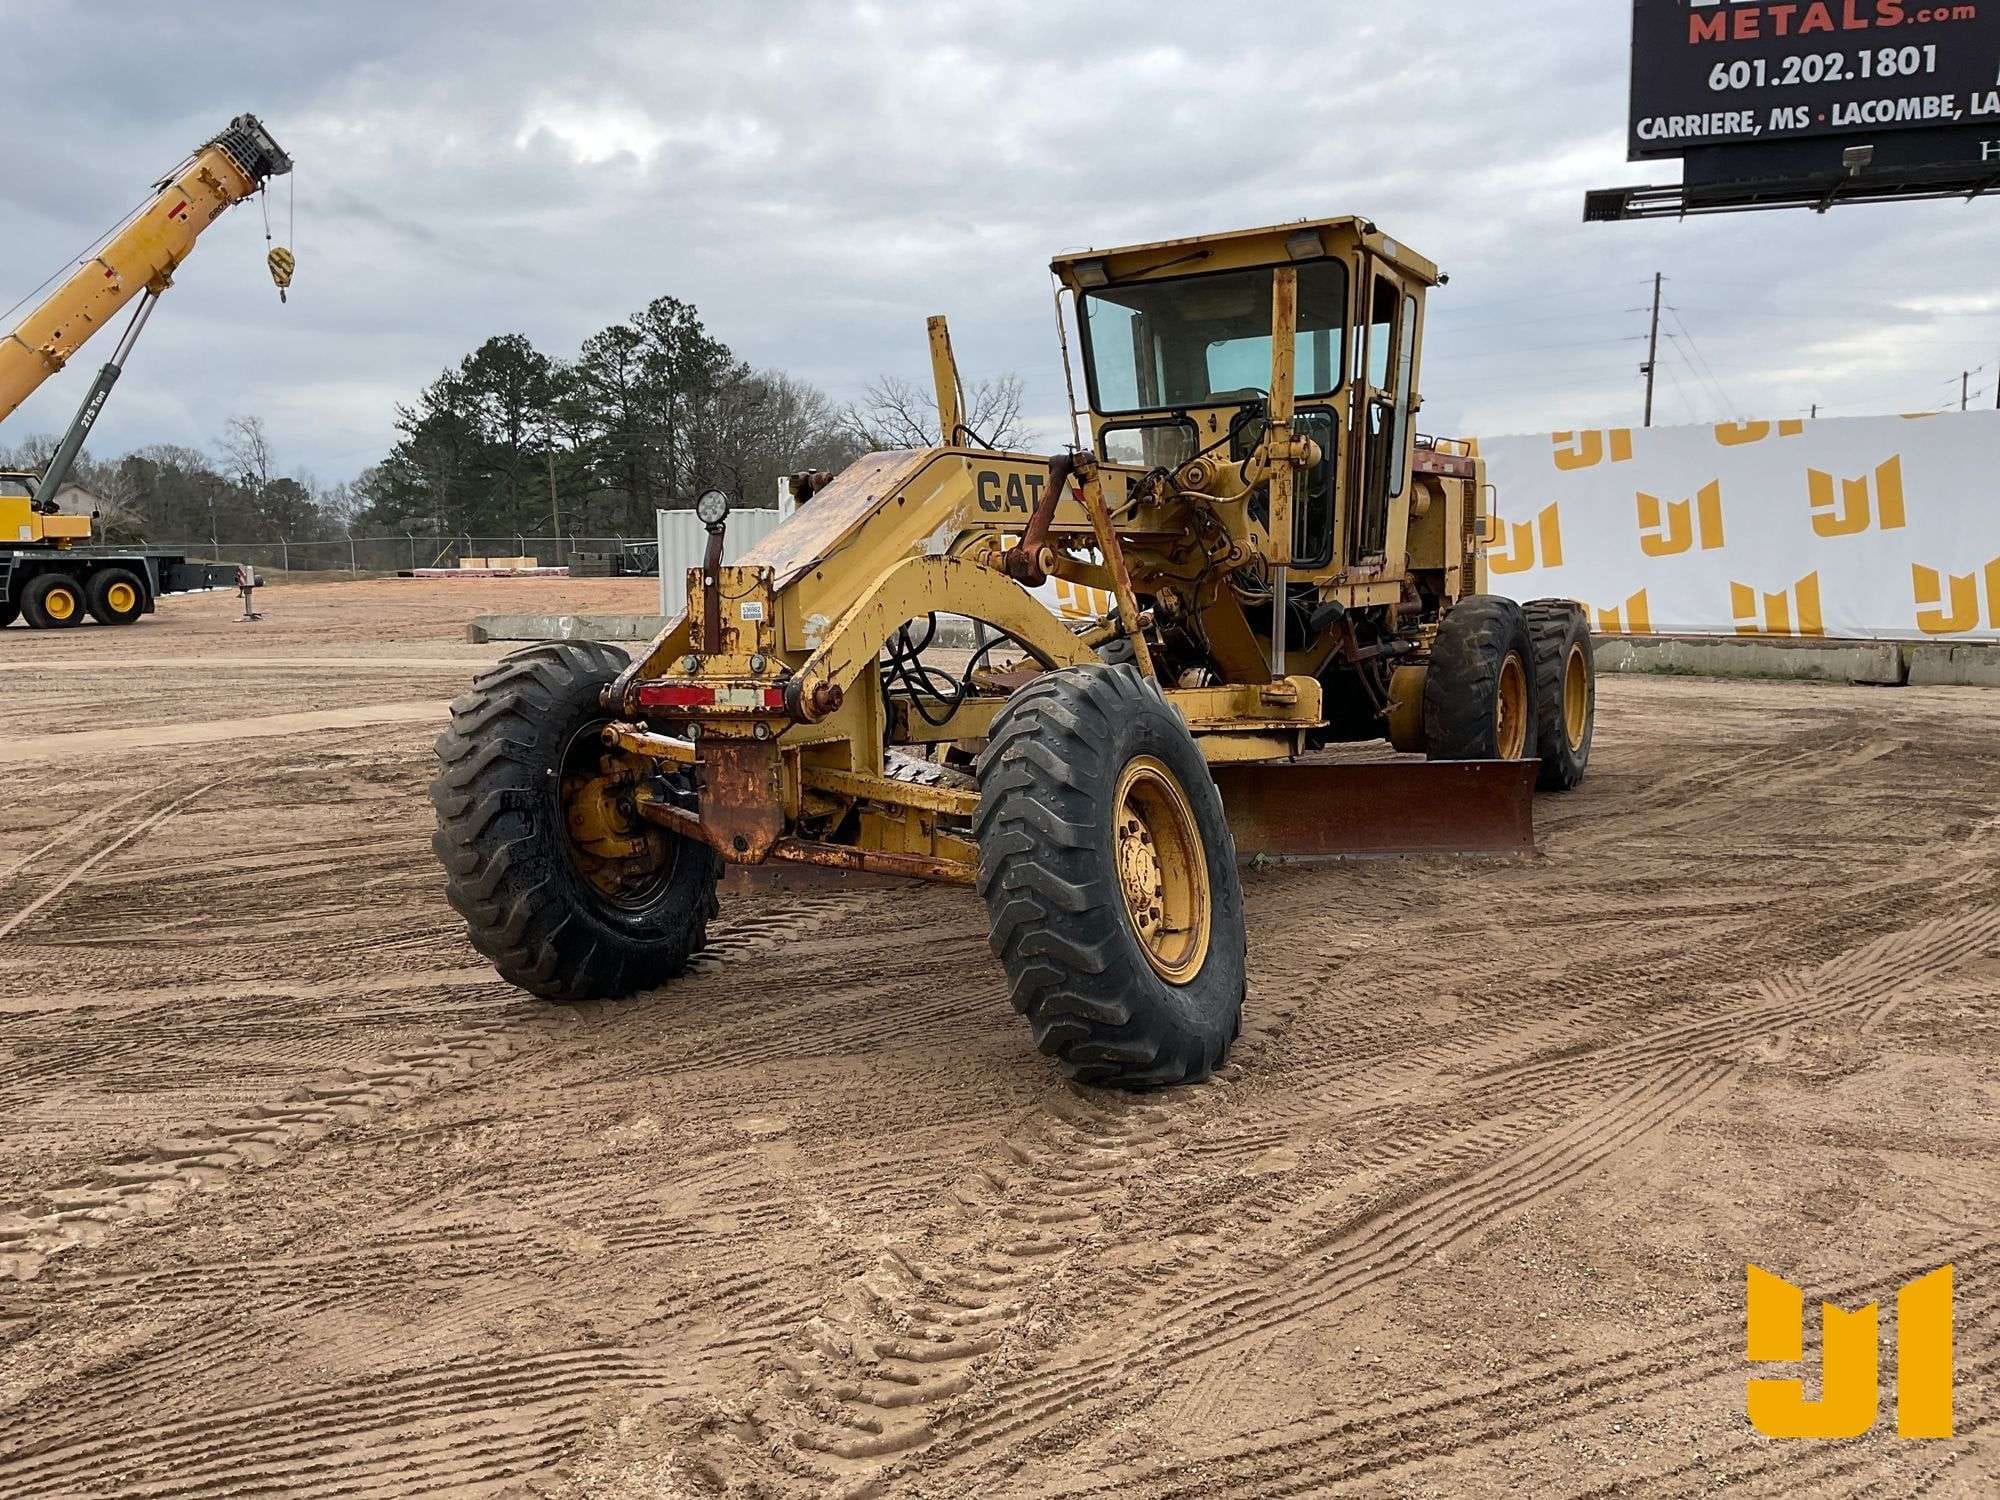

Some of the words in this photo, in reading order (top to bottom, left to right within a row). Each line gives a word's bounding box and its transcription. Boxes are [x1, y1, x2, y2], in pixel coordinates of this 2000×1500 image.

[1689, 0, 1976, 43] METALS.com
[1708, 44, 1936, 91] 601.202.1801
[1636, 110, 1763, 140] CARRIERE,
[1769, 105, 1811, 131] MS
[1831, 94, 1964, 126] LACOMBE,
[1971, 91, 2000, 115] LA
[81, 408, 96, 428] 275
[90, 390, 106, 409] Ton
[977, 470, 1043, 513] CAT
